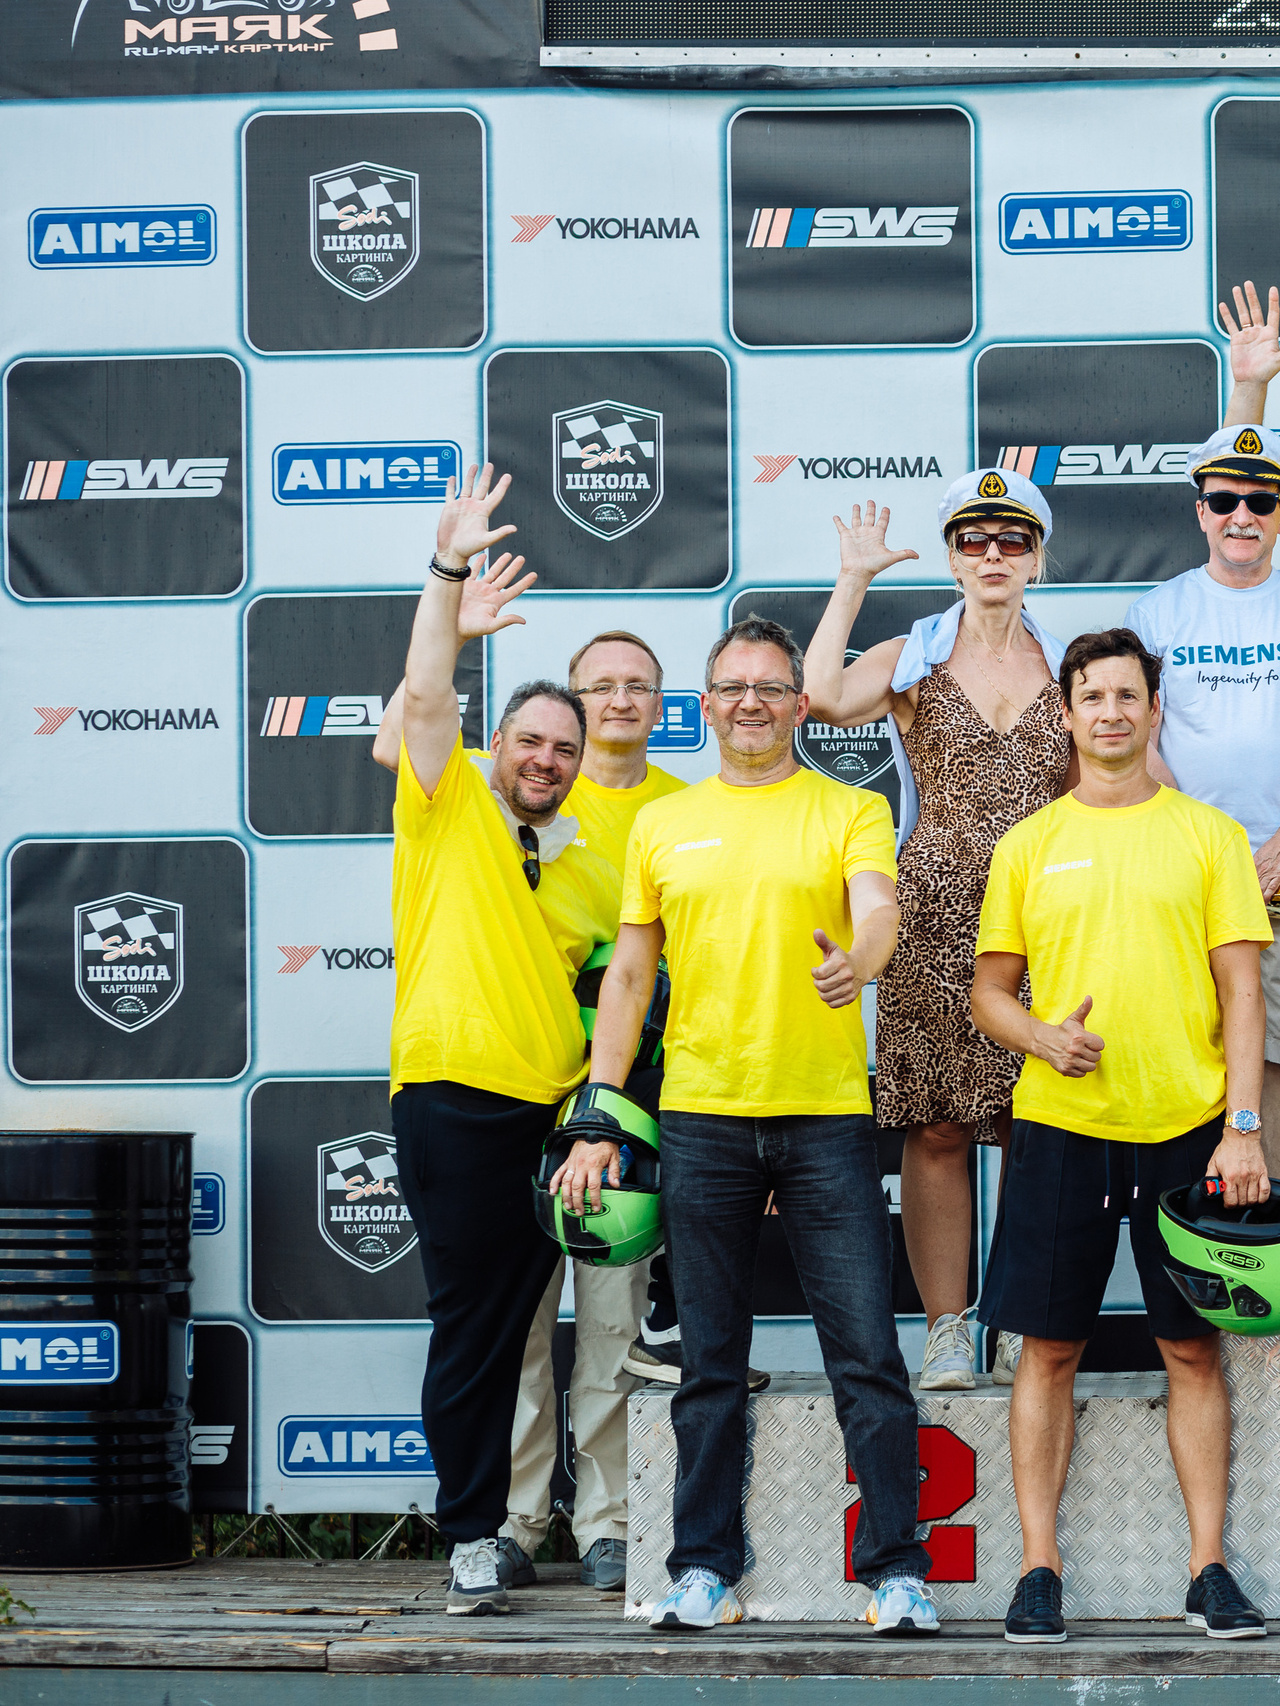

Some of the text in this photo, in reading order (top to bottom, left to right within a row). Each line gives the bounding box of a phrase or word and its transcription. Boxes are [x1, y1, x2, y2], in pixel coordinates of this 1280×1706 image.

[124, 14, 334, 44] МАЯК
[124, 43, 334, 57] RU-MAY КАРТИНГ
[338, 204, 392, 231] Sodi
[556, 217, 700, 241] YOKOHAMA
[323, 233, 407, 252] ШКОЛА
[336, 250, 393, 263] КАРТИНГА
[580, 444, 635, 470] Sodi
[799, 456, 942, 479] YOKOHAMA
[566, 472, 650, 491] ШКОЛА
[579, 490, 638, 502] КАРТИНГА
[1197, 670, 1262, 692] Ingenuity
[78, 709, 220, 732] YOKOHAMA
[820, 741, 879, 751] КАРТИНГА
[674, 838, 723, 853] SIEMENS
[1043, 858, 1093, 875] SIEMENS
[102, 935, 156, 962] Sodi
[87, 964, 171, 982] ШКОЛА
[100, 982, 158, 994] КАРТИНГА
[345, 1175, 399, 1201] Sodi
[330, 1205, 413, 1222] ШКОЛА
[343, 1224, 400, 1234] КАРТИНГА
[287, 1430, 433, 1463] AIMO
